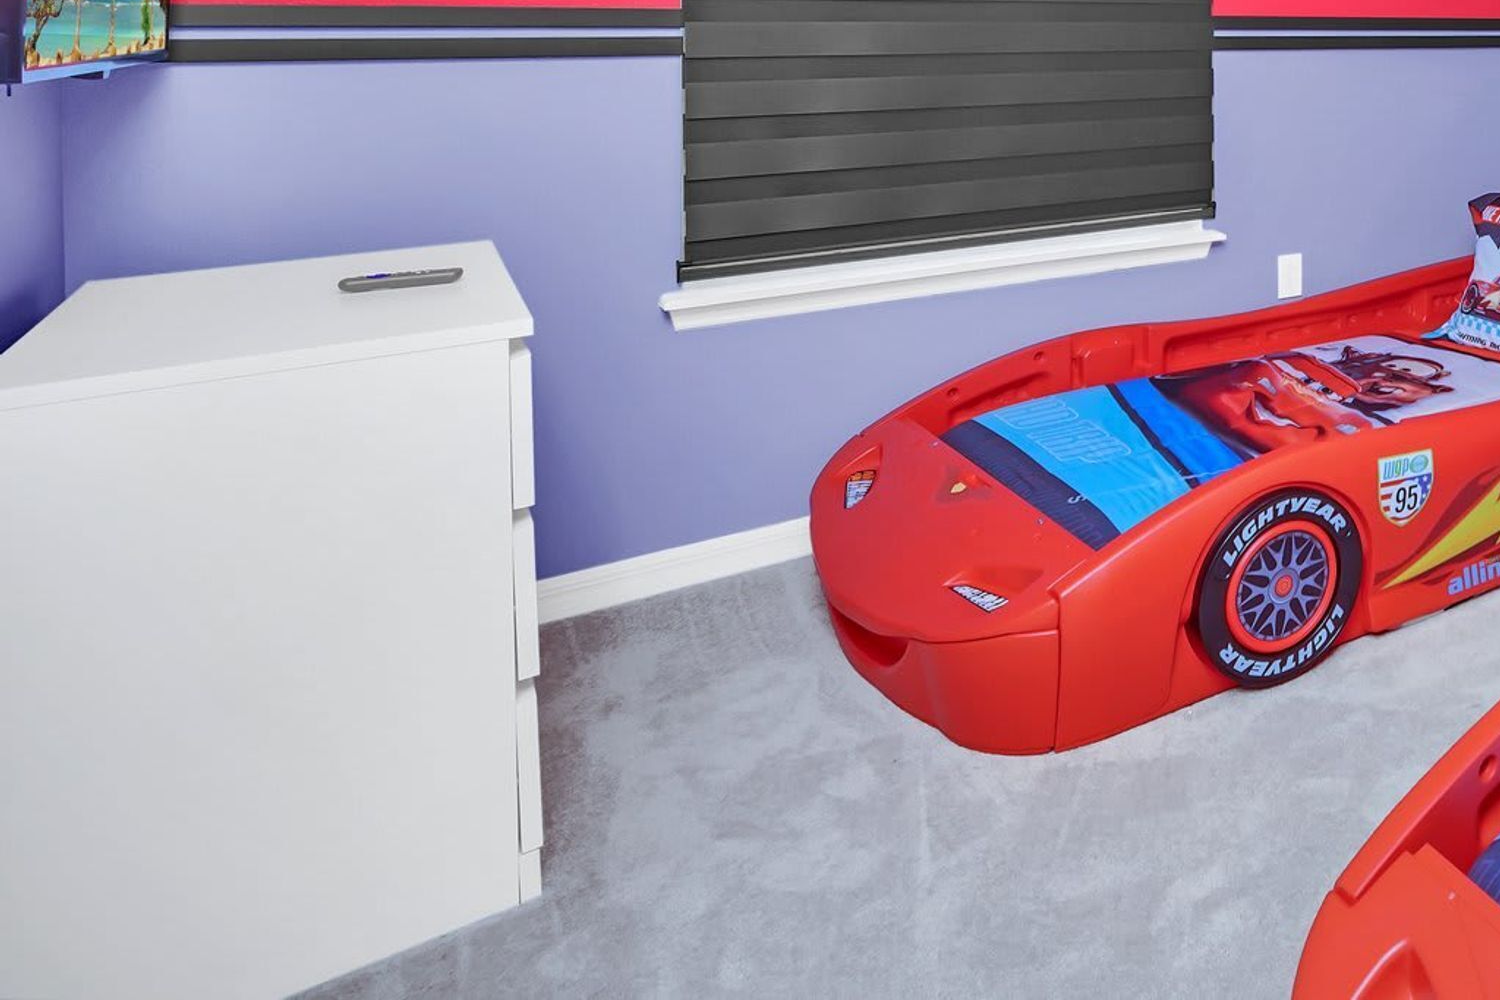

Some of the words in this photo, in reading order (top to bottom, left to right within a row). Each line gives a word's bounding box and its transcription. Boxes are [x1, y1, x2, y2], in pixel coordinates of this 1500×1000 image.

[1223, 497, 1347, 567] LIGHTYEAR
[1395, 484, 1418, 513] 95
[1218, 604, 1345, 677] LIGHTYEAR
